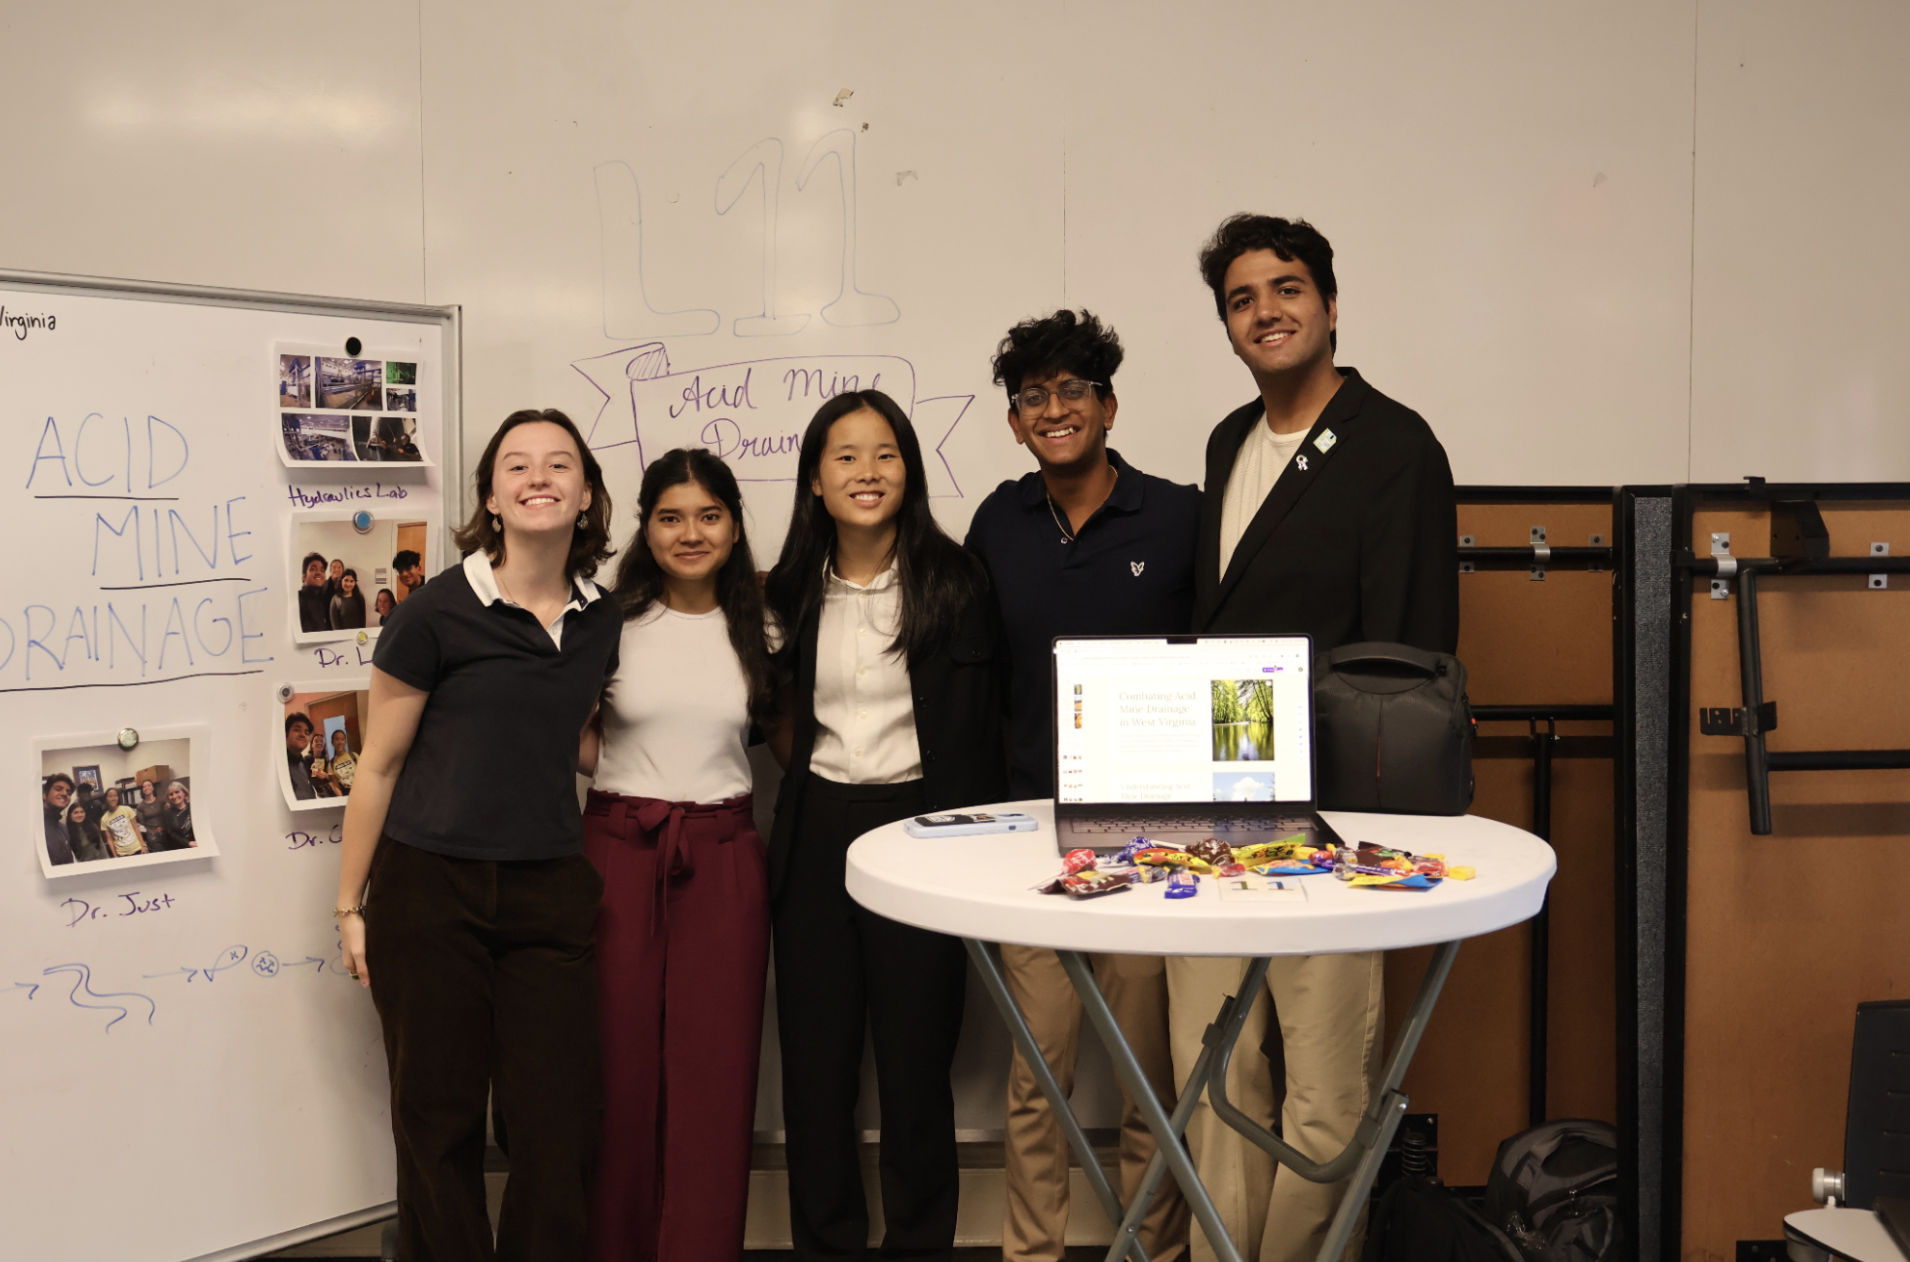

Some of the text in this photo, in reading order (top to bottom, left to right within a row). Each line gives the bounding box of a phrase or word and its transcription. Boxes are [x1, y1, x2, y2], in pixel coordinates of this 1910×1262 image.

[669, 367, 758, 418] Acid
[26, 412, 189, 493] ACID
[701, 418, 801, 460] Drain
[288, 482, 408, 509] Hydraulics Lab
[93, 496, 253, 580] MINE
[314, 647, 349, 668] Dr.
[1119, 691, 1197, 702] Combating Acid
[1119, 704, 1190, 716] Mine Drainage
[1119, 716, 1197, 728] in West Virginia
[285, 831, 324, 850] Dr.
[60, 891, 176, 928] Dr. Just
